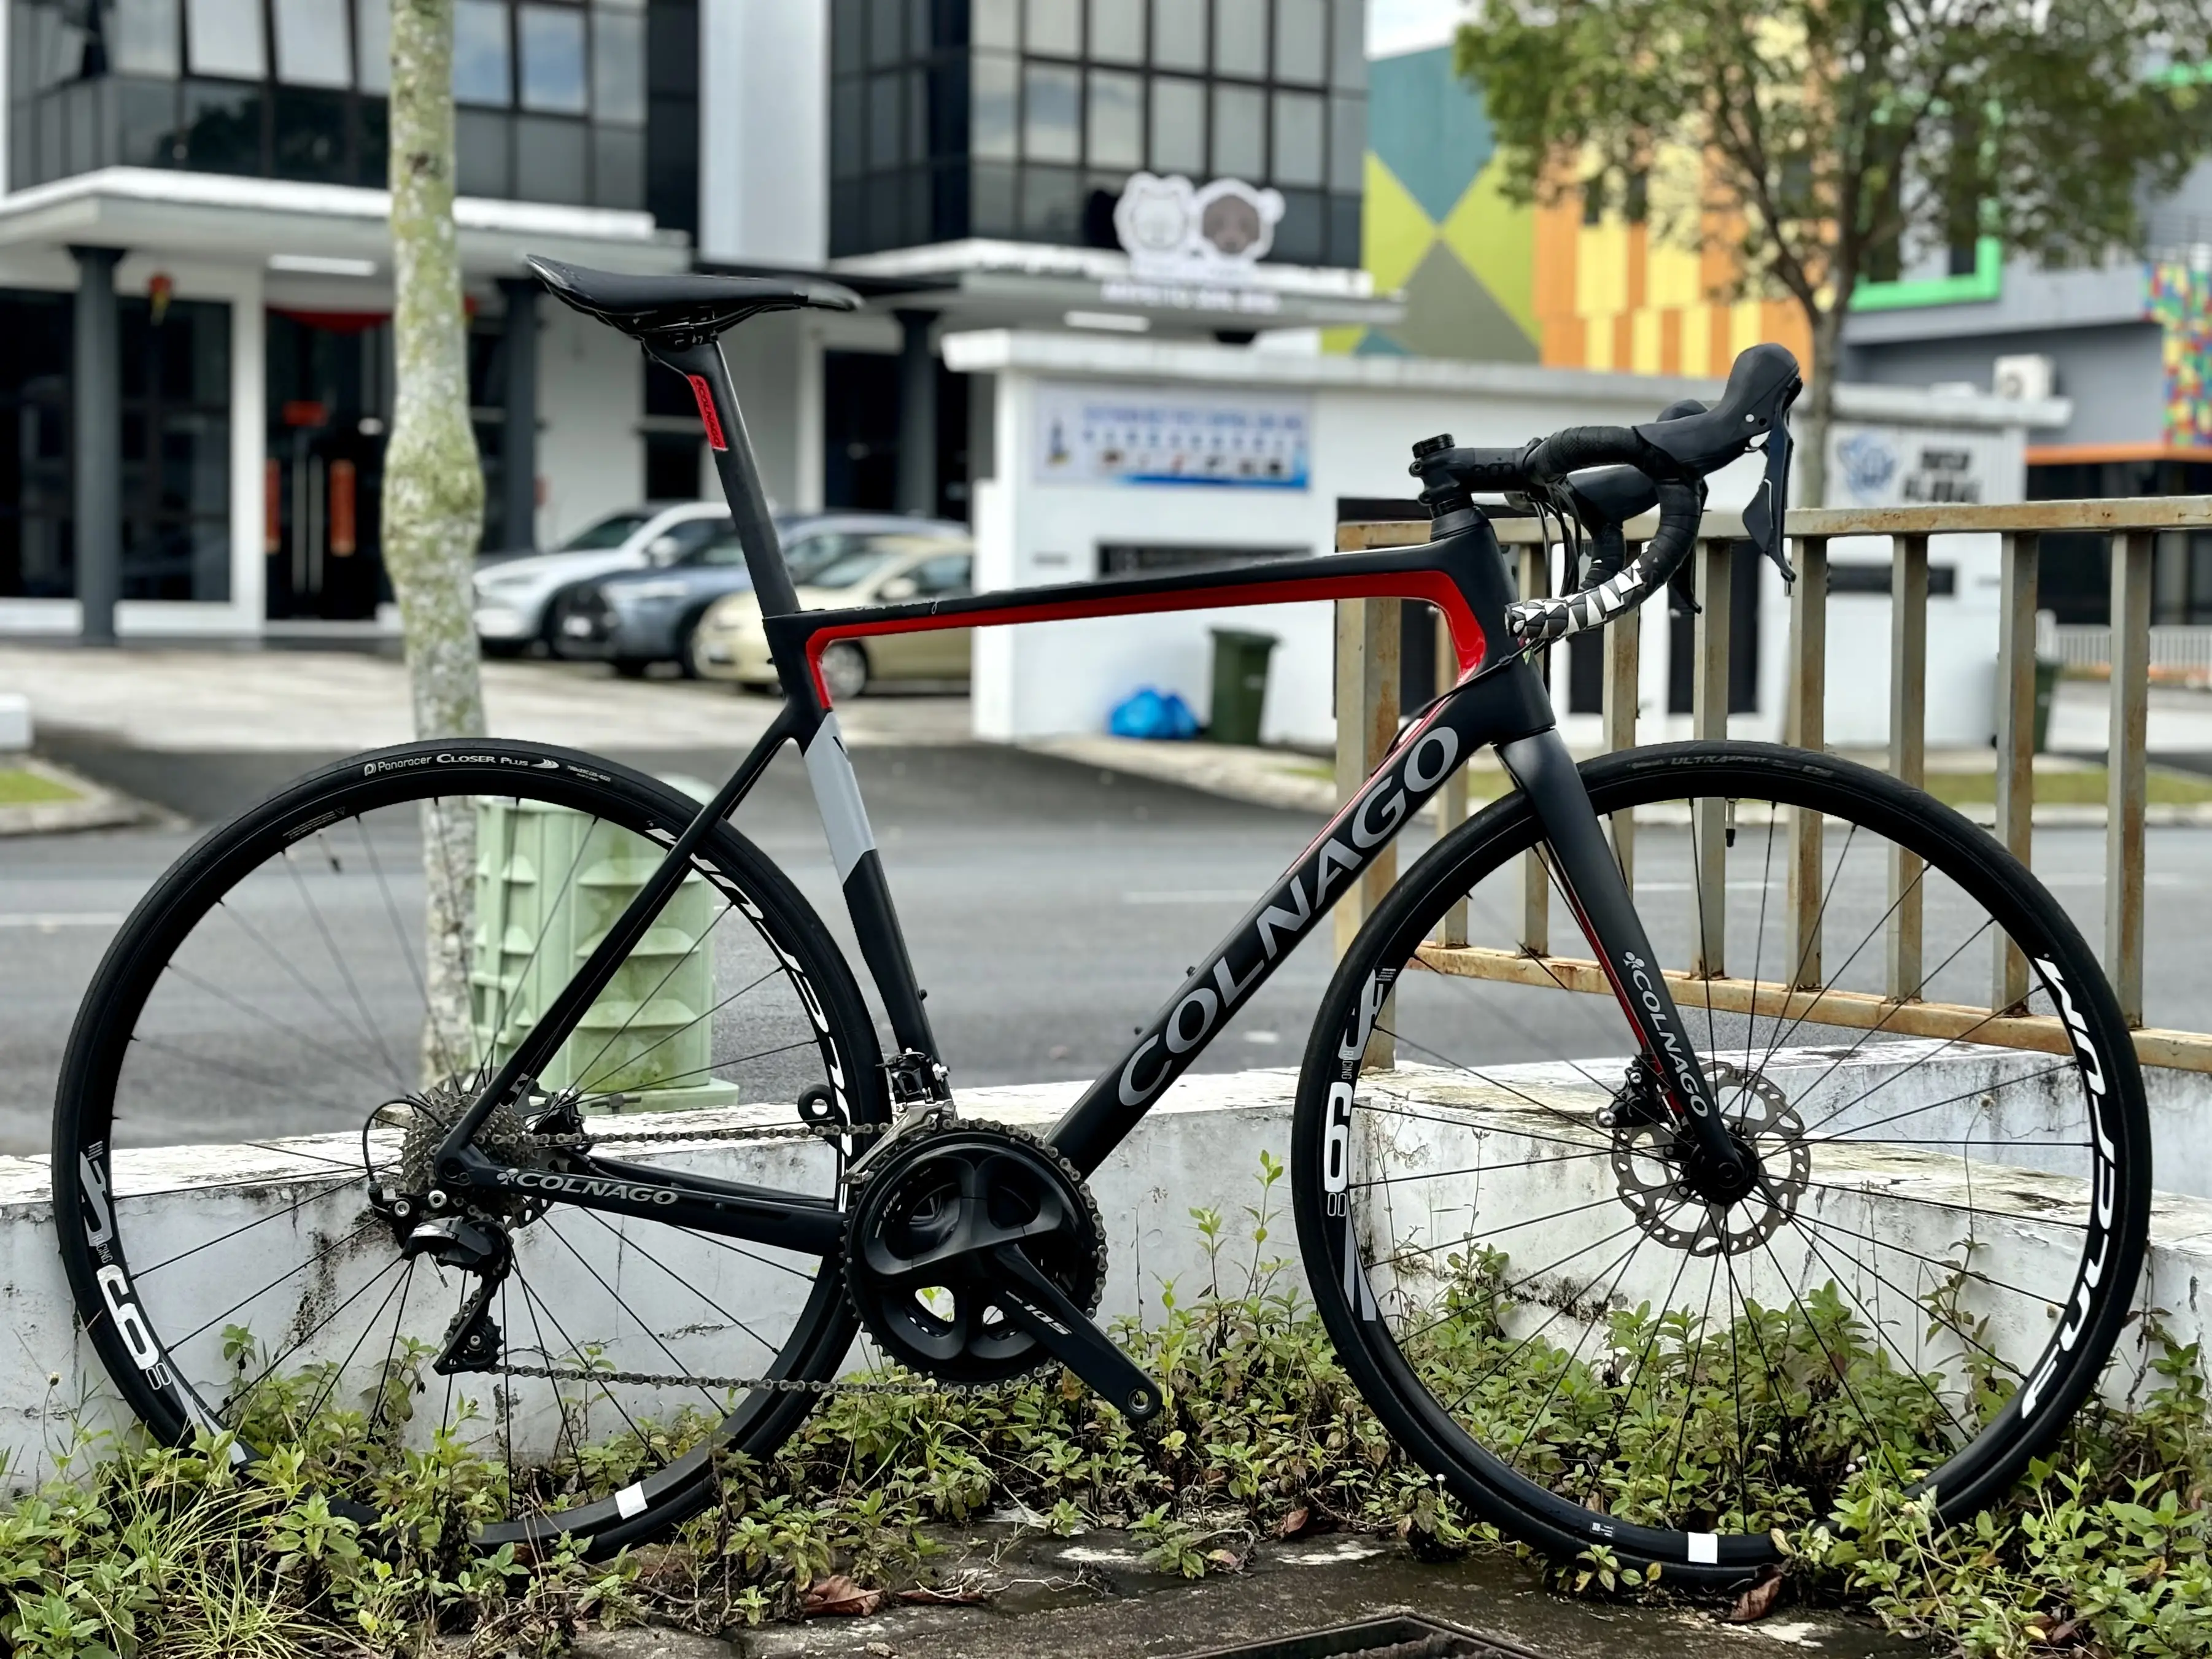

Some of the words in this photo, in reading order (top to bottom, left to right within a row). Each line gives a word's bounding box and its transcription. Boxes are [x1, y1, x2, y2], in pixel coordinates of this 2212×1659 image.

[377, 756, 432, 772] Panaracer
[1671, 756, 1728, 765] ULTRA
[1118, 726, 1459, 1106] COLNAGO
[1632, 969, 1709, 1118] COLNAGO
[1341, 1050, 1354, 1080] RACING
[516, 1173, 679, 1205] COLNAGO
[92, 1233, 114, 1264] RACING
[1023, 1305, 1073, 1336] 105
